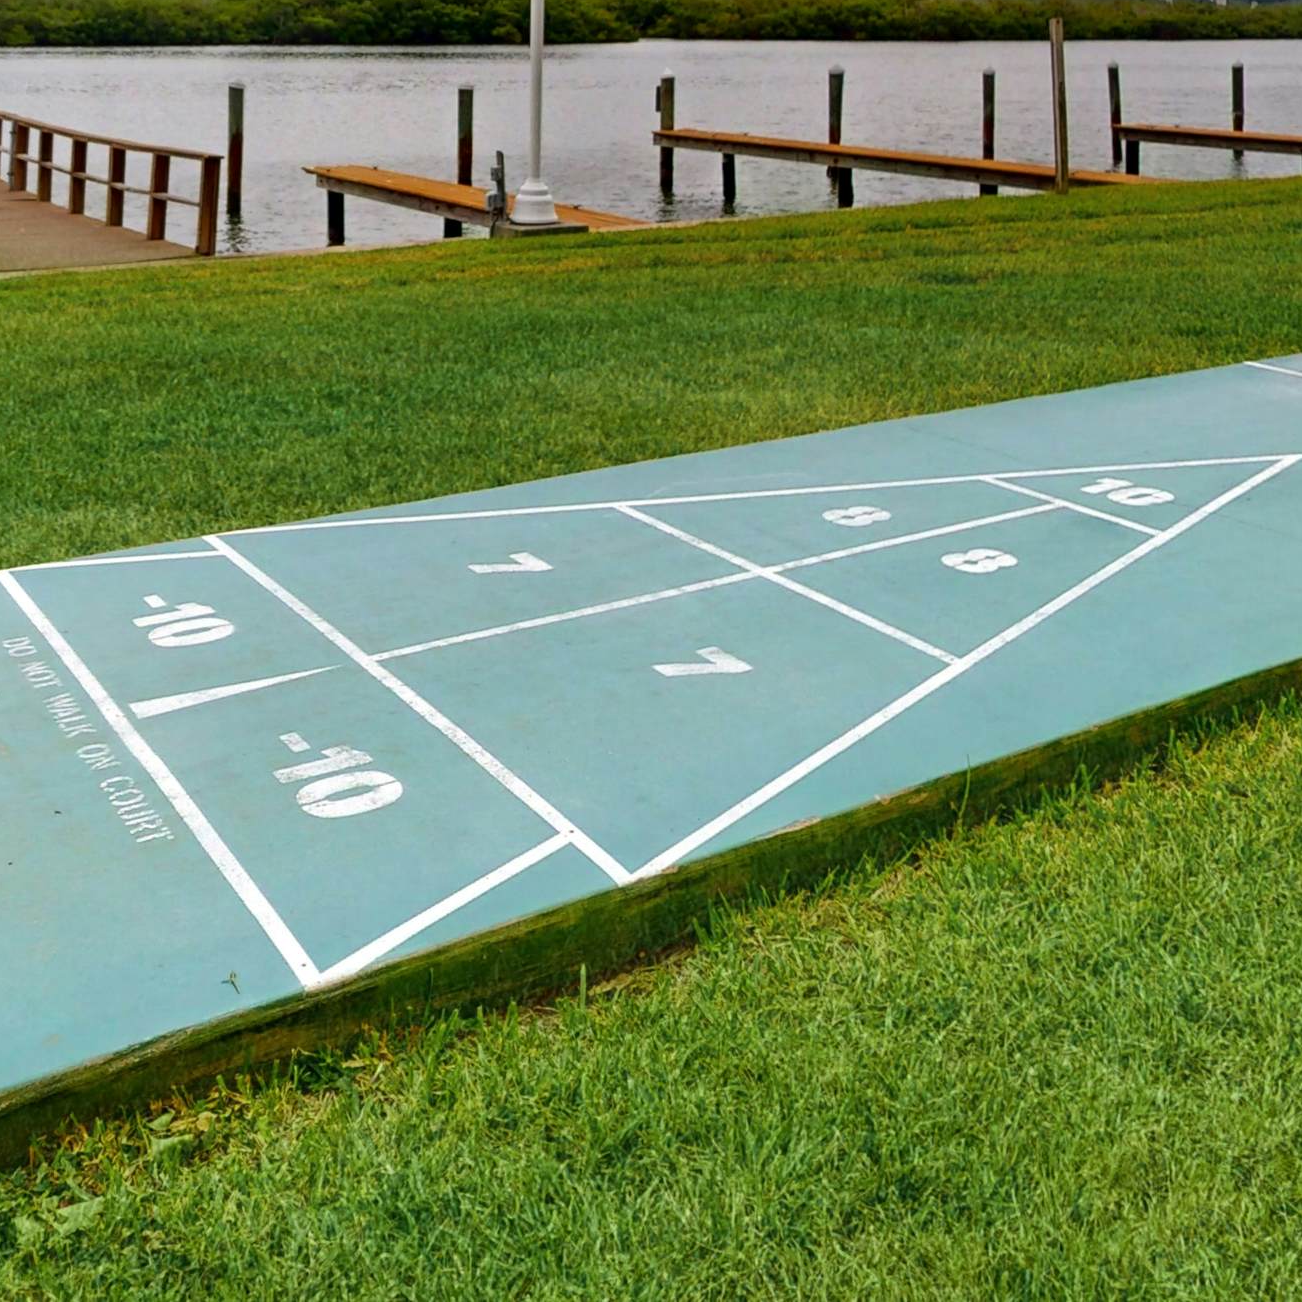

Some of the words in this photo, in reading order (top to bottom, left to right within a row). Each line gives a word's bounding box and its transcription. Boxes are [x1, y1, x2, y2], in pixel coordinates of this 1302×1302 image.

[1079, 477, 1176, 506] 10
[821, 505, 892, 527] 8
[467, 552, 555, 574] 7
[940, 548, 1019, 574] 8
[2, 636, 38, 657] DO
[18, 661, 64, 689] NOT
[652, 646, 754, 677] 7
[42, 692, 97, 738] WALK
[76, 743, 122, 770] ON
[100, 775, 175, 843] COURT
